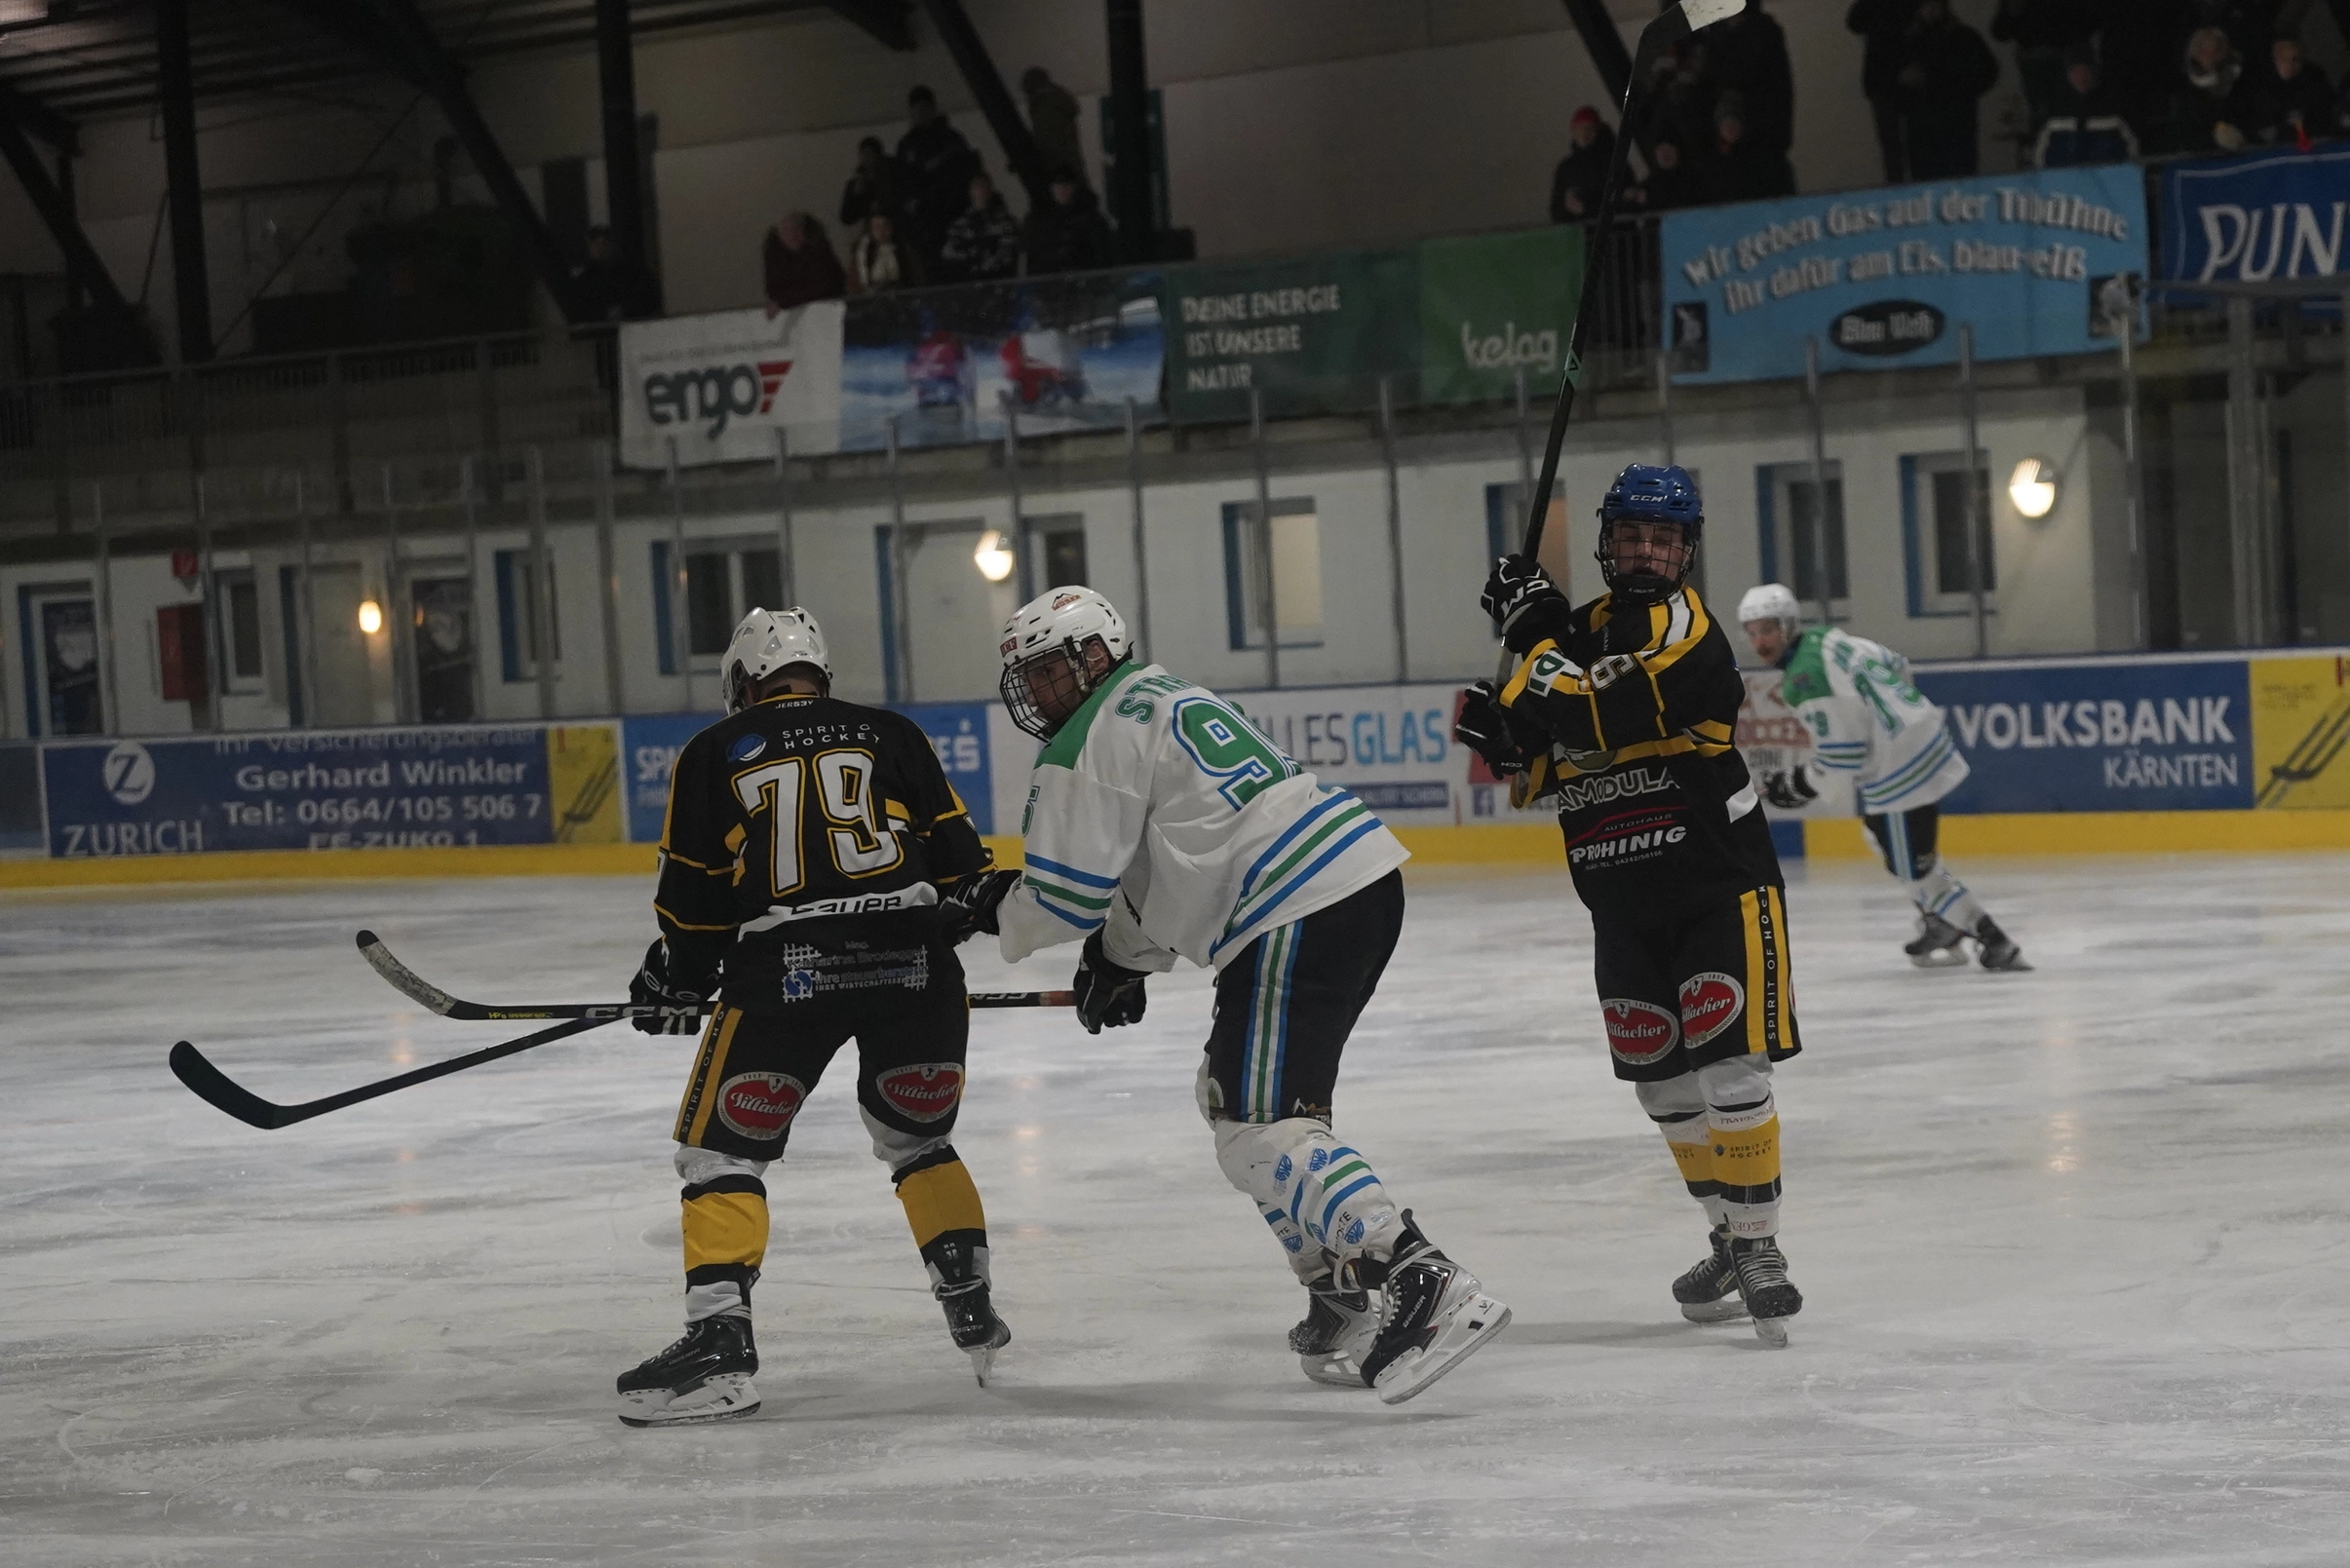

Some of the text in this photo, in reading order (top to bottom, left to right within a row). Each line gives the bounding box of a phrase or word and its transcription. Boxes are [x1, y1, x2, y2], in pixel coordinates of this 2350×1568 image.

[1684, 247, 1731, 287] wir
[1736, 216, 1821, 271] geben
[1826, 203, 1879, 237] Gas
[1886, 189, 1932, 227] auf
[1939, 189, 1988, 223] der
[2198, 201, 2350, 285] PUN
[1770, 257, 1841, 298] dafür
[1849, 249, 1894, 281] am
[1180, 285, 1340, 324] DEINE ENERGIE
[1185, 324, 1301, 358] IST UNSERE
[1463, 321, 1558, 373] kelag
[1187, 363, 1252, 392] NATUR
[783, 725, 847, 739] SPIRIT
[785, 733, 880, 749] HOCKEY
[1952, 696, 2236, 749] VOLKSBANK
[1173, 697, 1302, 812] 9
[2103, 748, 2238, 787] KÄRNTEN
[236, 757, 527, 791] Gerhard Winkler
[222, 792, 542, 827] Tel: 0664/105 506 7
[730, 746, 905, 899] 79
[1604, 813, 1673, 831] AUTOHAUS
[62, 820, 204, 857] ZURICH
[1569, 826, 1687, 863] PROHINIG
[1765, 948, 1776, 970] OF
[585, 1006, 700, 1019] CCM
[1767, 980, 1777, 1040] SPIRIT
[681, 1078, 704, 1134] SPIRIT
[703, 1047, 713, 1067] OF
[1403, 1294, 1427, 1328] BAUER
